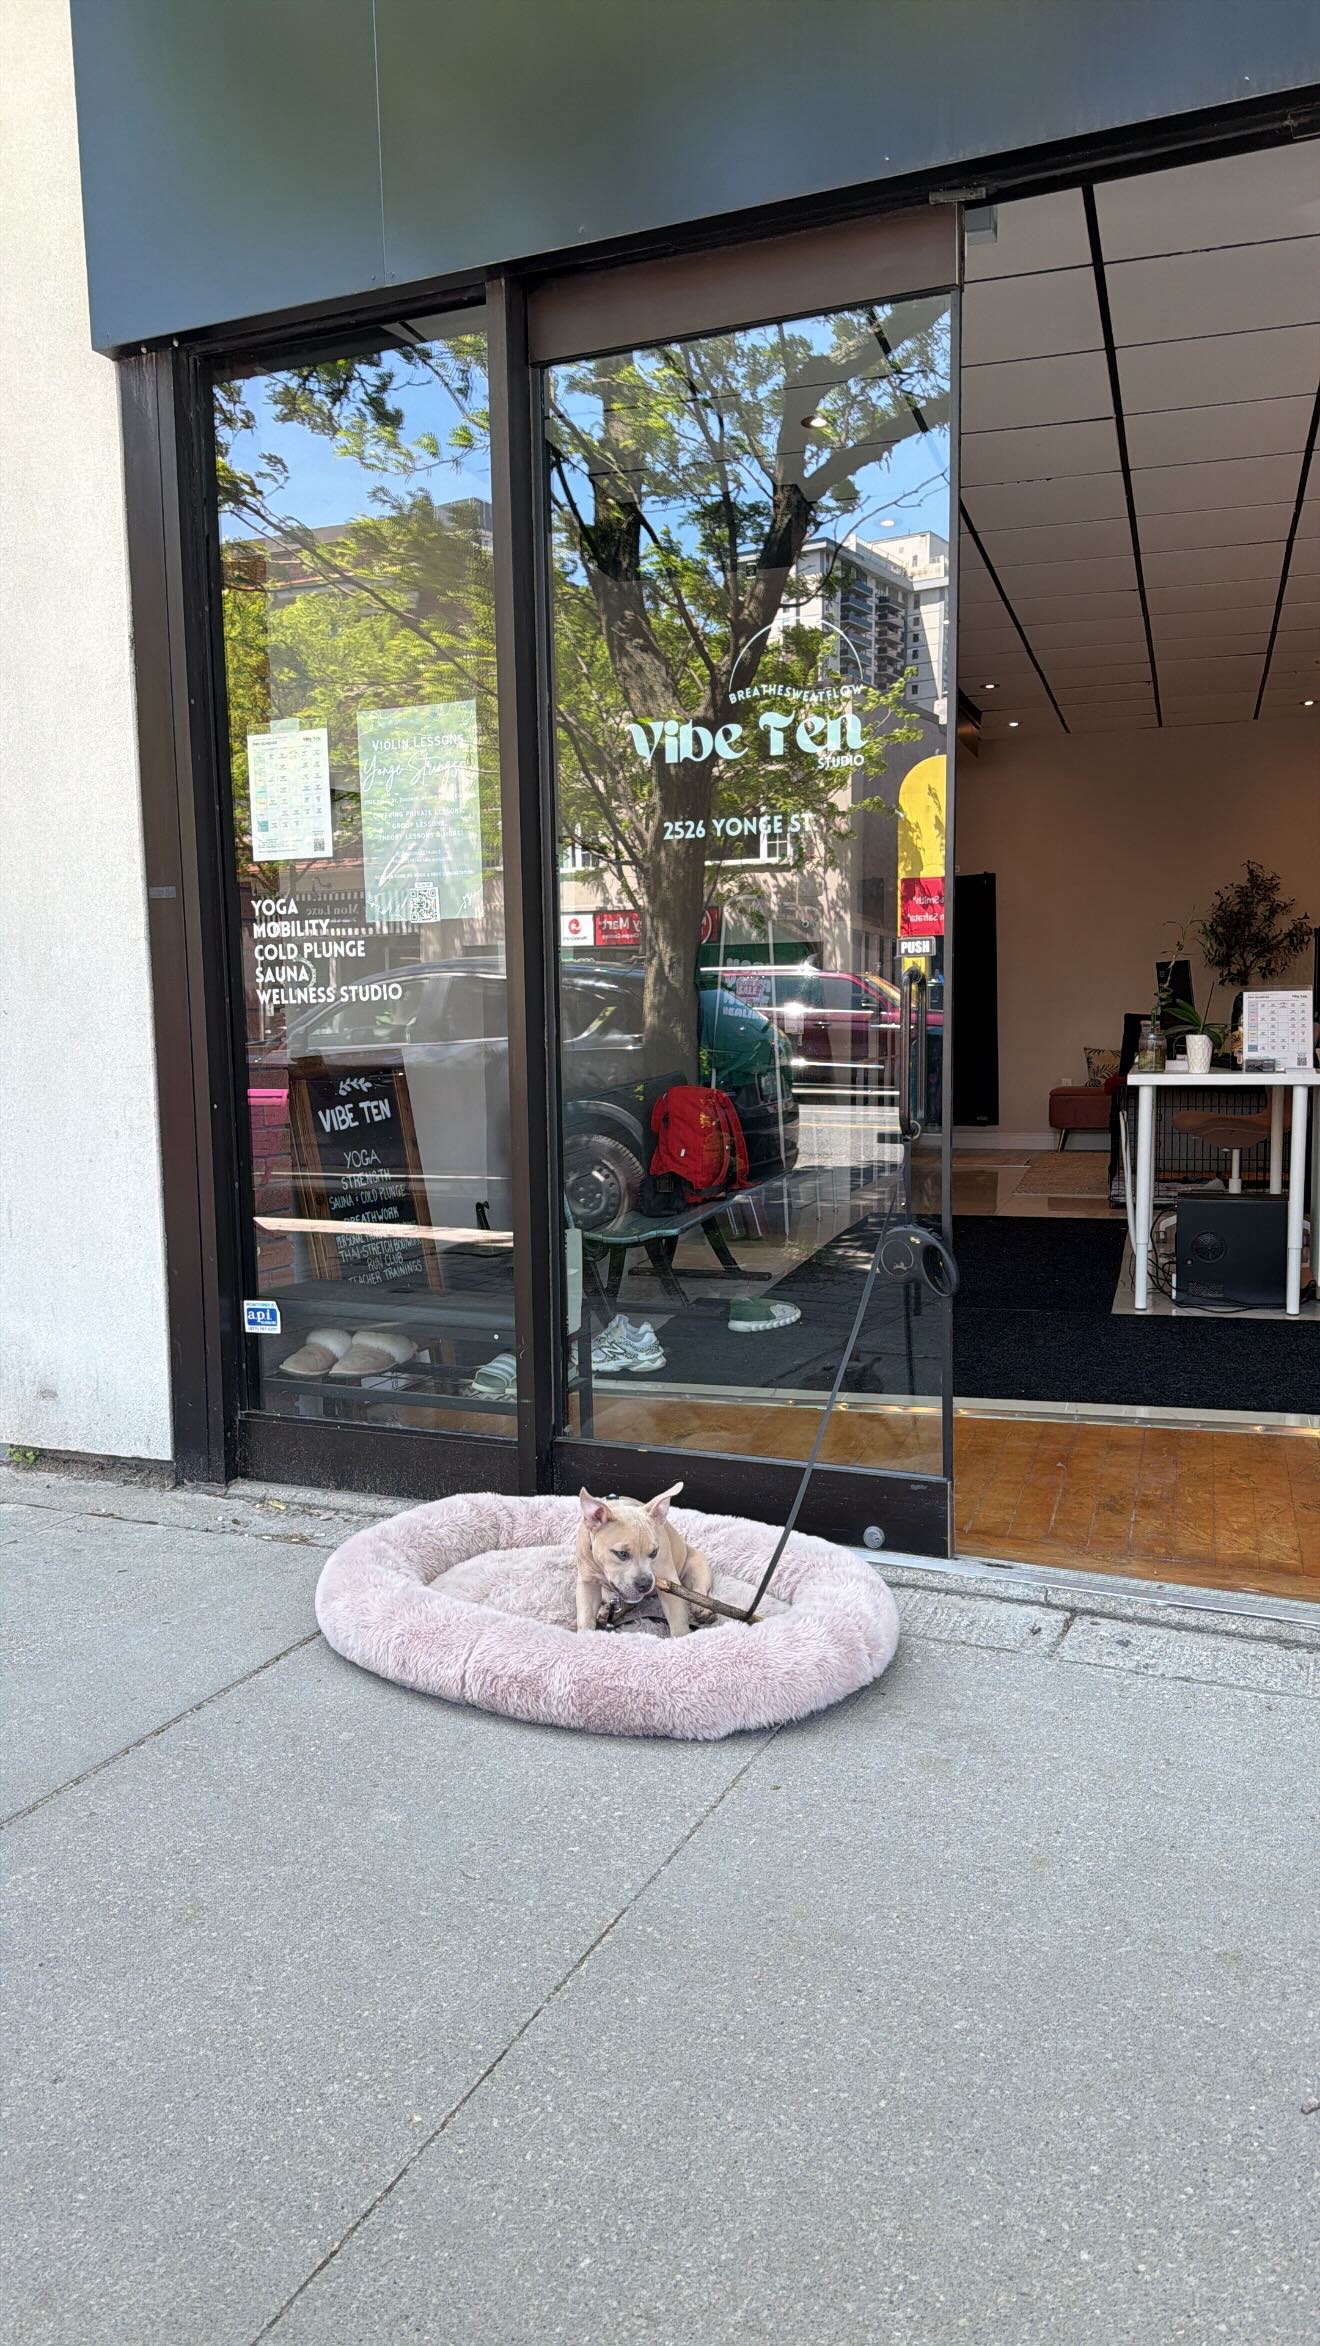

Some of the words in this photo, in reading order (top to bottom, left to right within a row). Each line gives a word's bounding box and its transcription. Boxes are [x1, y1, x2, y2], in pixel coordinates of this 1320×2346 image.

[372, 738, 408, 751] VIOLIN
[627, 718, 749, 763] Vibe
[758, 710, 869, 756] Ten
[817, 755, 865, 769] STUDIO
[663, 820, 706, 840] 2526
[712, 815, 783, 836] YONGE
[251, 898, 299, 917] YOGA
[253, 918, 330, 939] MOBILITY
[254, 943, 298, 961] COLD
[303, 940, 366, 958] PLUNGE
[900, 940, 930, 954] PUSH
[255, 965, 310, 983] SAUNA
[256, 986, 336, 1005] WELLNESS
[340, 983, 403, 1003] STUDIO
[318, 1103, 359, 1133] VIBE
[358, 1098, 392, 1124] TEN
[343, 1148, 382, 1169] YOGA
[340, 1167, 392, 1191] STRENGTH
[383, 1259, 423, 1281] TRAININGS
